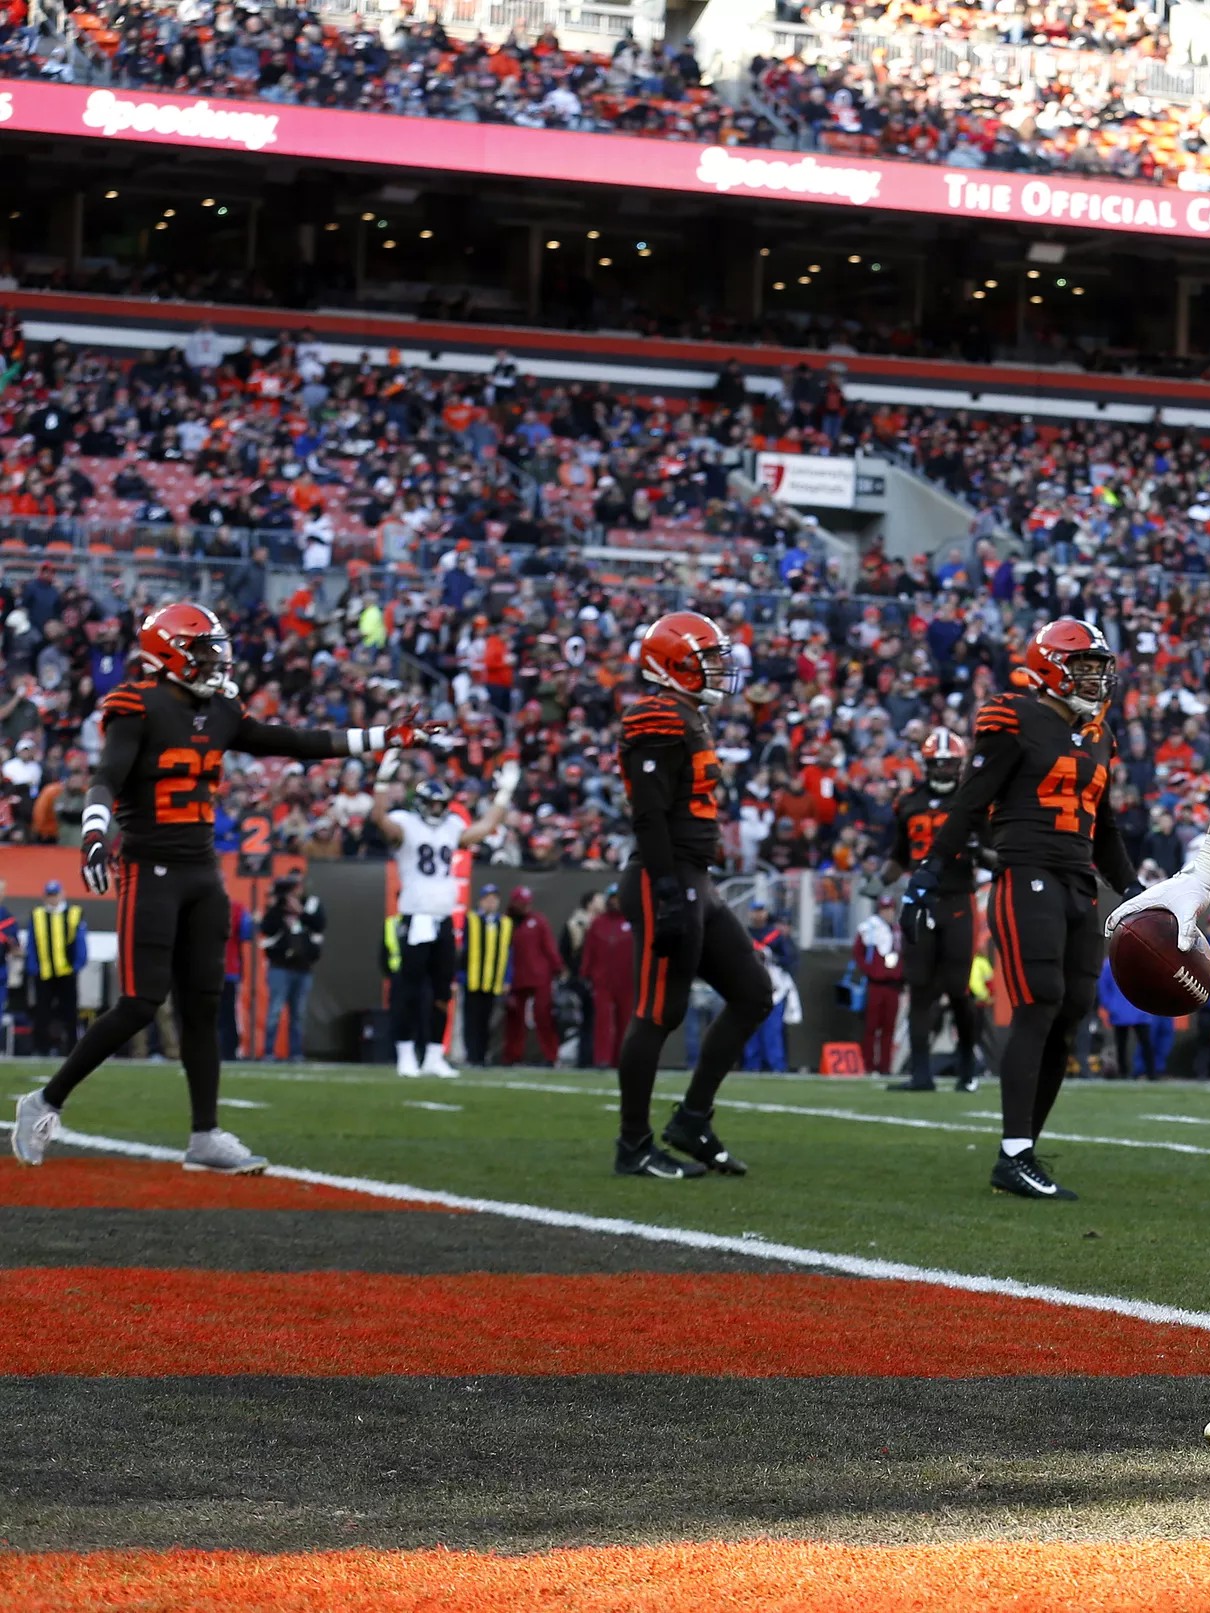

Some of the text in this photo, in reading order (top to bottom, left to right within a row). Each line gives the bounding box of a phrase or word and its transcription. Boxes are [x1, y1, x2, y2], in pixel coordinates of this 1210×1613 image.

[82, 89, 279, 150] Speedway
[696, 146, 882, 205] Speedway
[241, 816, 271, 854] 2
[417, 843, 452, 876] 89
[829, 1048, 859, 1074] 20
